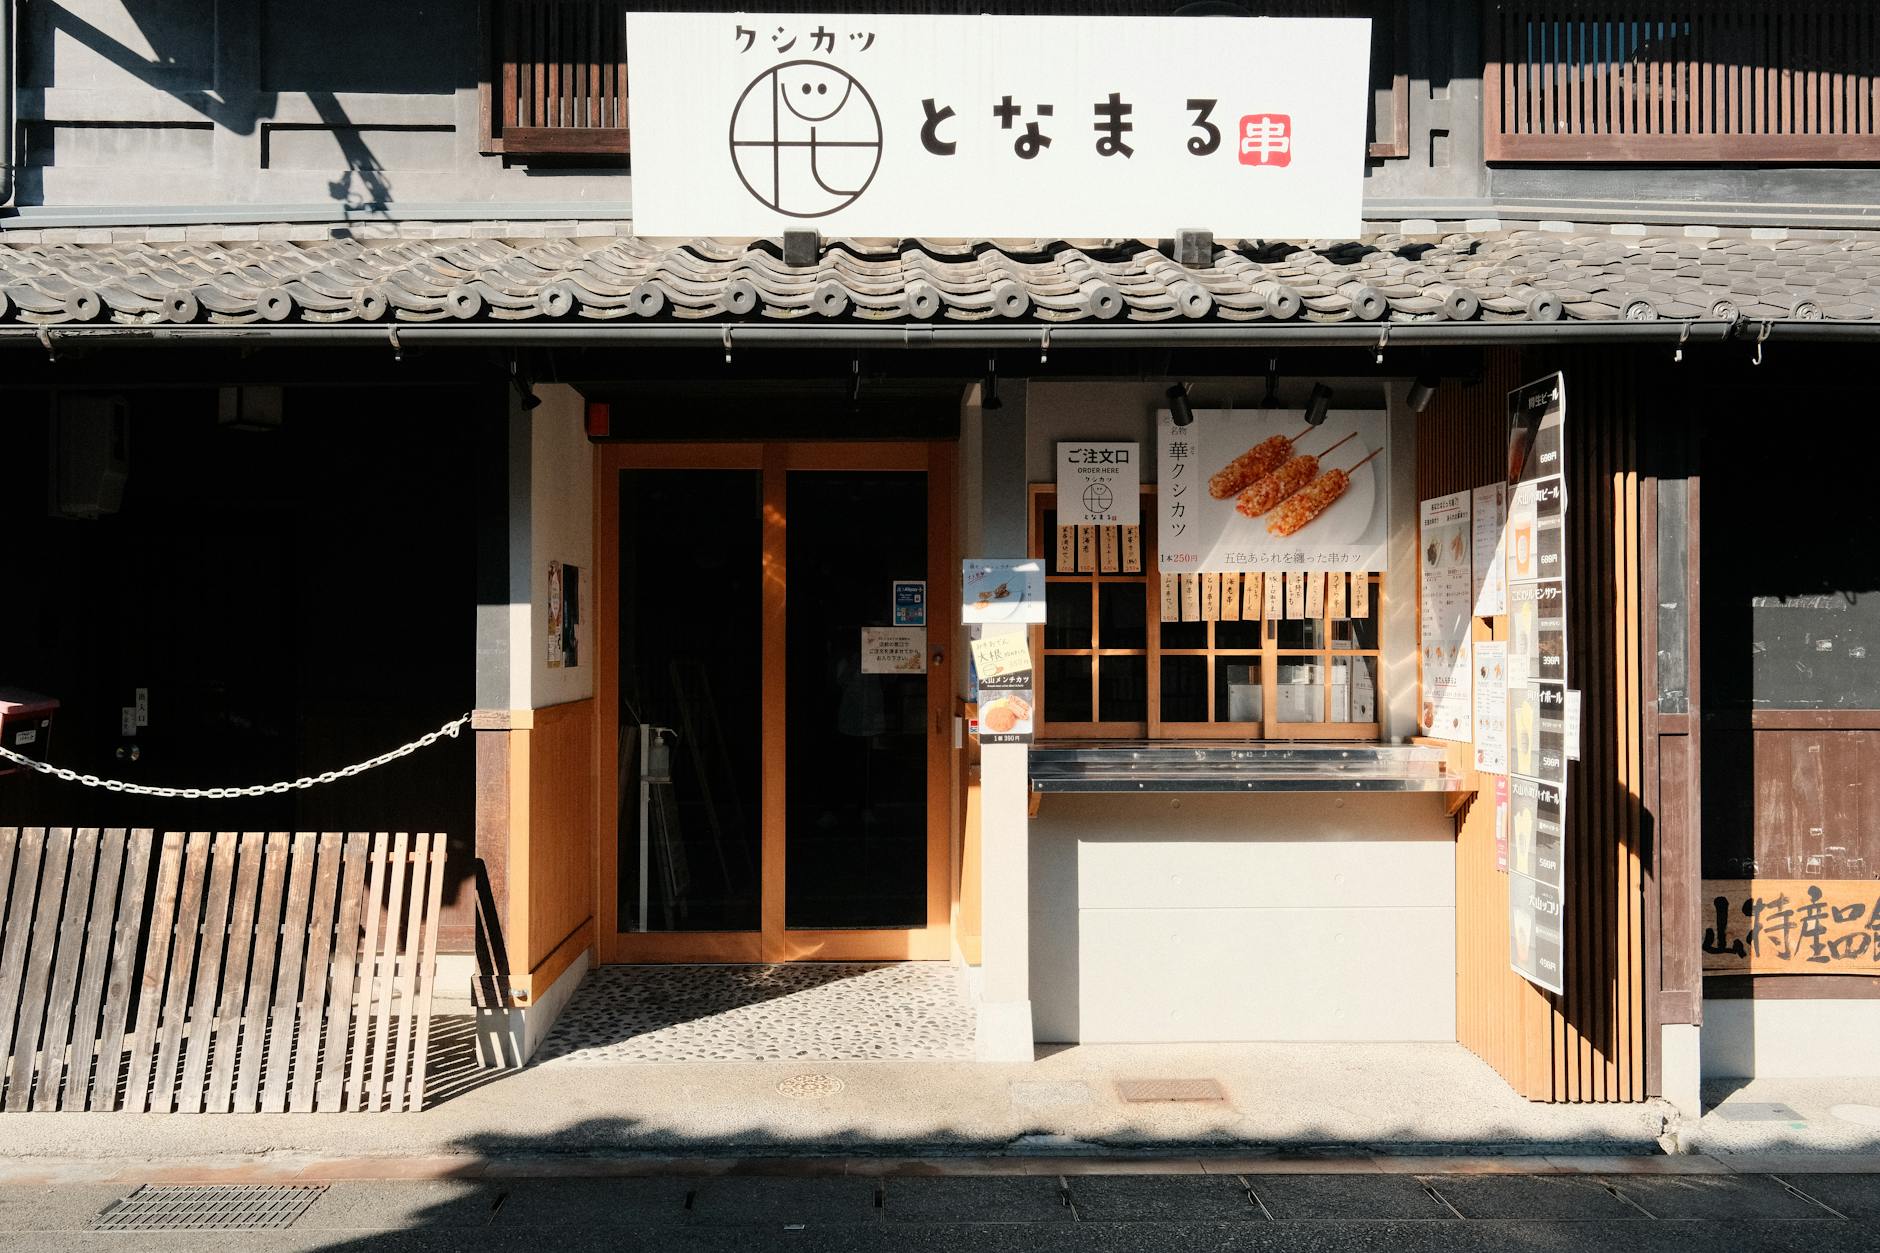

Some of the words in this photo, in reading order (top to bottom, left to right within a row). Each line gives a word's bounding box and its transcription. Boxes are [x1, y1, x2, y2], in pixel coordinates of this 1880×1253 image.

[735, 25, 876, 54] クシカツ
[920, 92, 1222, 160] となまる
[1242, 117, 1290, 164] 串
[1068, 448, 1129, 463] ご注文口
[1168, 441, 1188, 537] 華クシカツ
[1160, 553, 1197, 563] 1本250円
